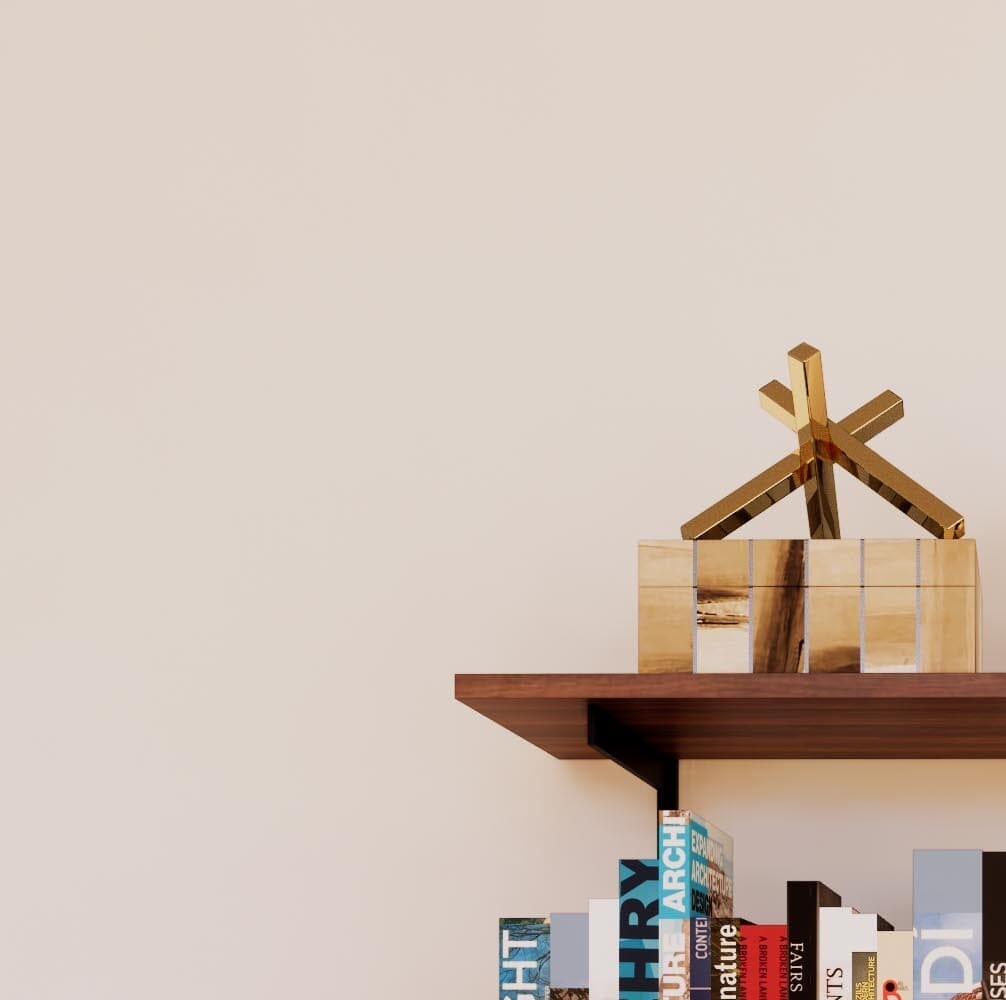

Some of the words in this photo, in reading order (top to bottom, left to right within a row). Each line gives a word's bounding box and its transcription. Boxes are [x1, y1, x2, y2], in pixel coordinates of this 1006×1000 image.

[663, 810, 686, 913] ARCHI
[759, 944, 767, 979] BROKEN
[779, 944, 787, 979] BROKEN
[791, 942, 804, 993] FAIRS
